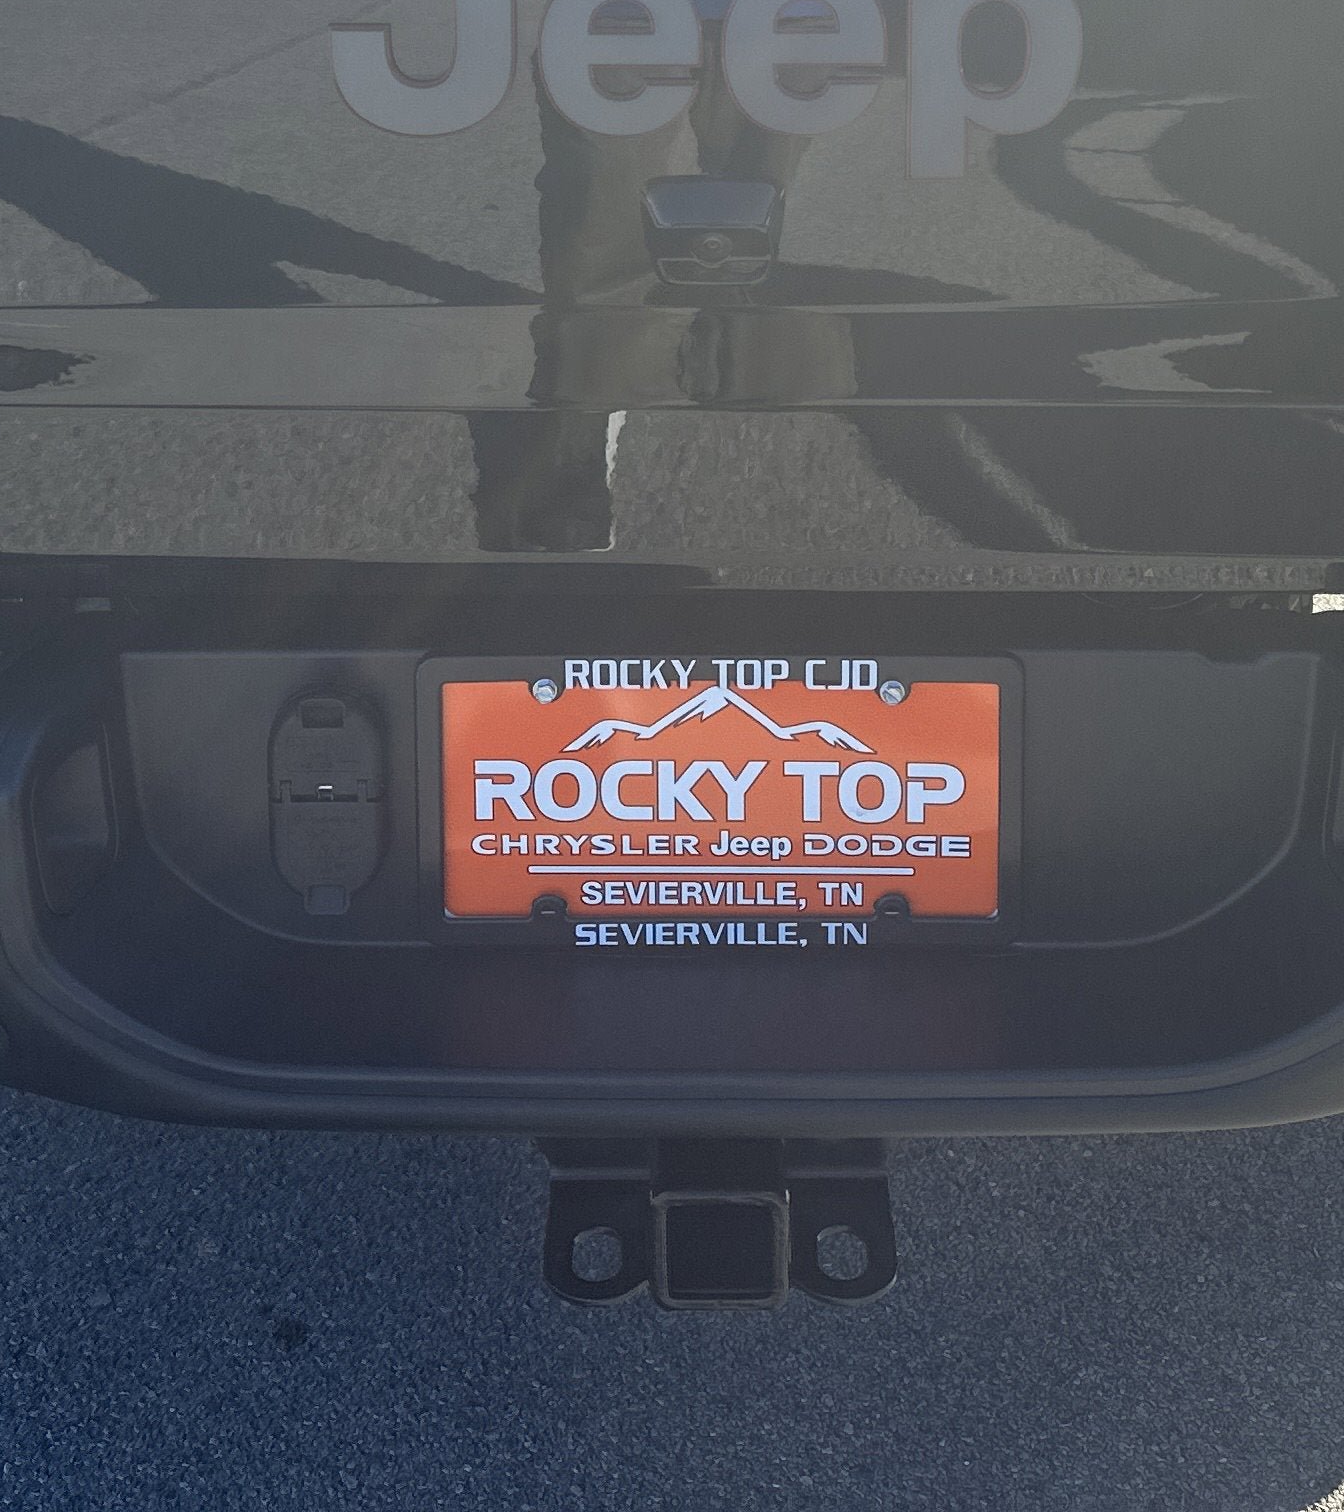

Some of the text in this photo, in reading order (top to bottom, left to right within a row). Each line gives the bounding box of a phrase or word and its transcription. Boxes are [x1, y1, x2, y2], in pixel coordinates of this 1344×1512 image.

[564, 659, 878, 690] ROCKY TOP CJD
[473, 759, 967, 824] ROCKY TOP
[471, 830, 971, 860] CHRYSLER Jeep DODGE
[580, 880, 864, 910] SEVIERVILLE, TN
[575, 922, 868, 948] SEVIERVILLE, TN
